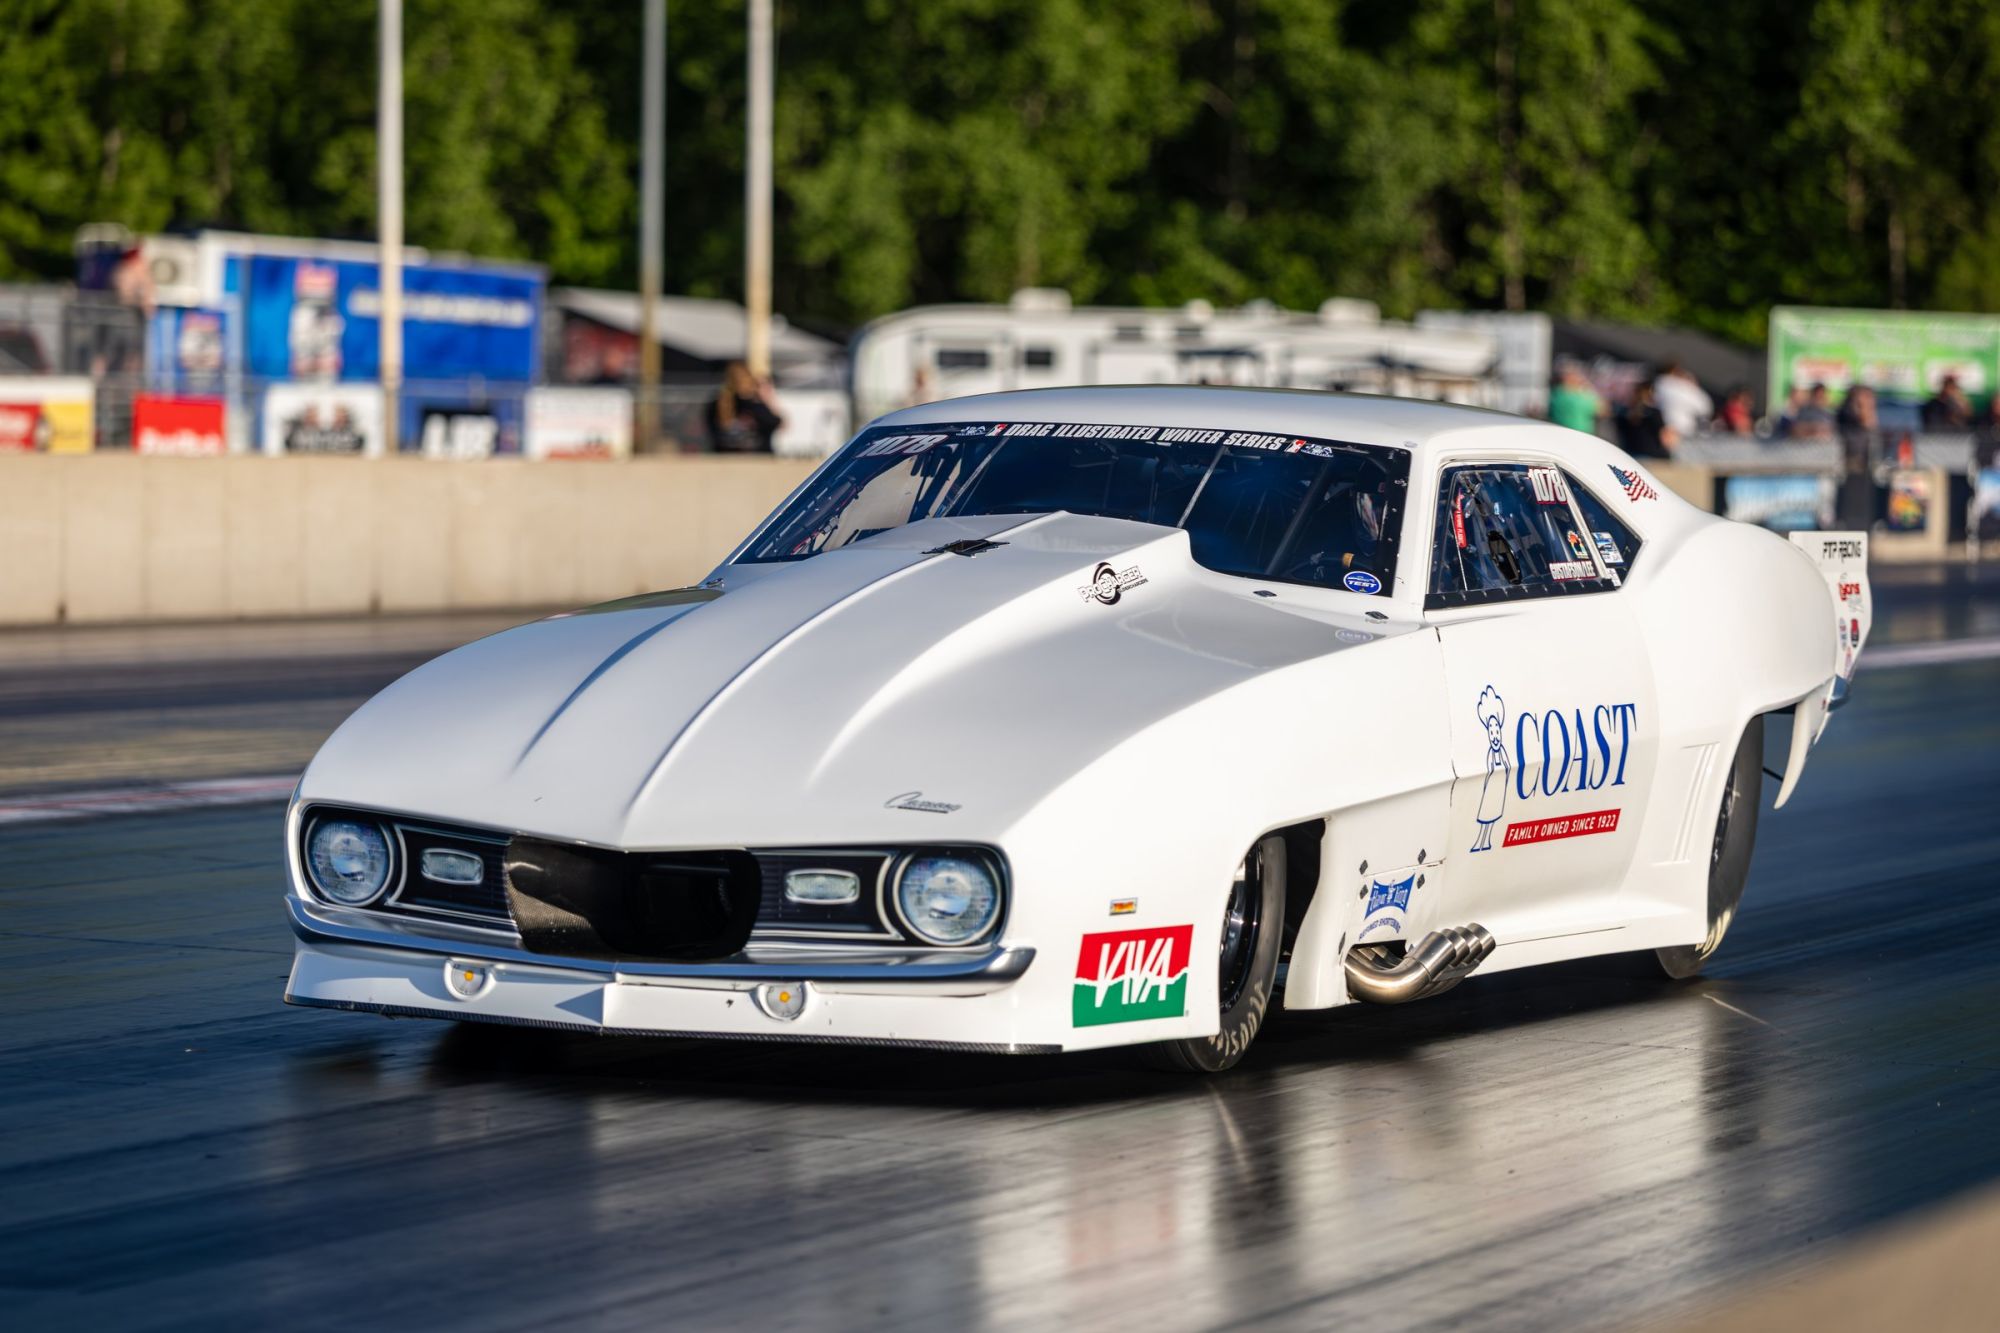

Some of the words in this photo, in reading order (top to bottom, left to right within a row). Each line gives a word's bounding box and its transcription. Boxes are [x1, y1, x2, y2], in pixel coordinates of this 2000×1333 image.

[855, 434, 949, 458] 1078
[1003, 423, 1055, 437] DRAG
[1052, 424, 1159, 441] ILLUSTRATED
[1157, 428, 1226, 444] WINTER
[1223, 432, 1287, 451] SERIES
[1528, 467, 1568, 504] 1078
[1516, 703, 1637, 800] COAST
[1507, 824, 1540, 842] FAMILY
[1540, 820, 1570, 838] OWNED
[1570, 816, 1596, 833] SINCE
[1597, 814, 1617, 829] 1922
[1094, 937, 1175, 1008] VIVA
